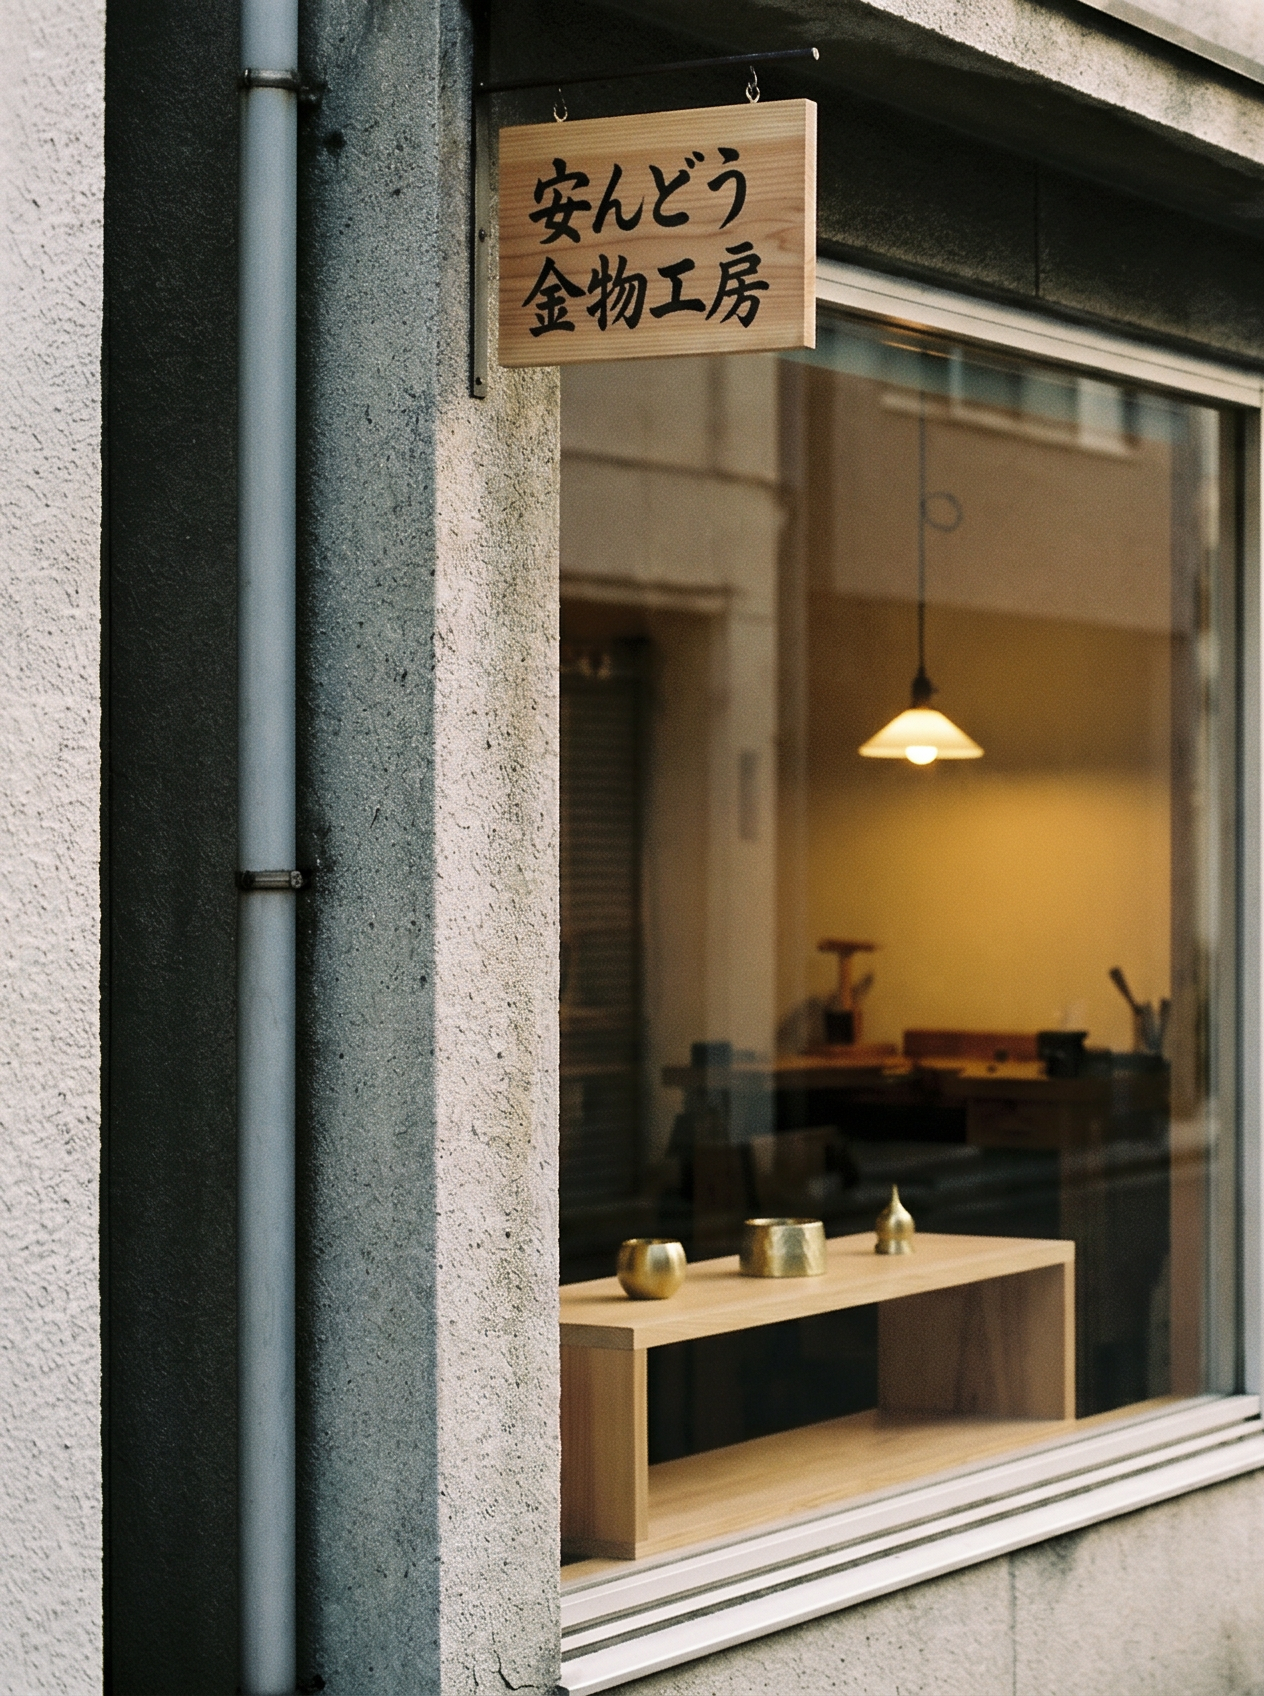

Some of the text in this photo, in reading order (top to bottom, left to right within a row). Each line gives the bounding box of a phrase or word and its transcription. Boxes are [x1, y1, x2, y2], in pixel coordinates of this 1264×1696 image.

[528, 147, 747, 245] 安んどう
[521, 241, 770, 338] 金物工房
